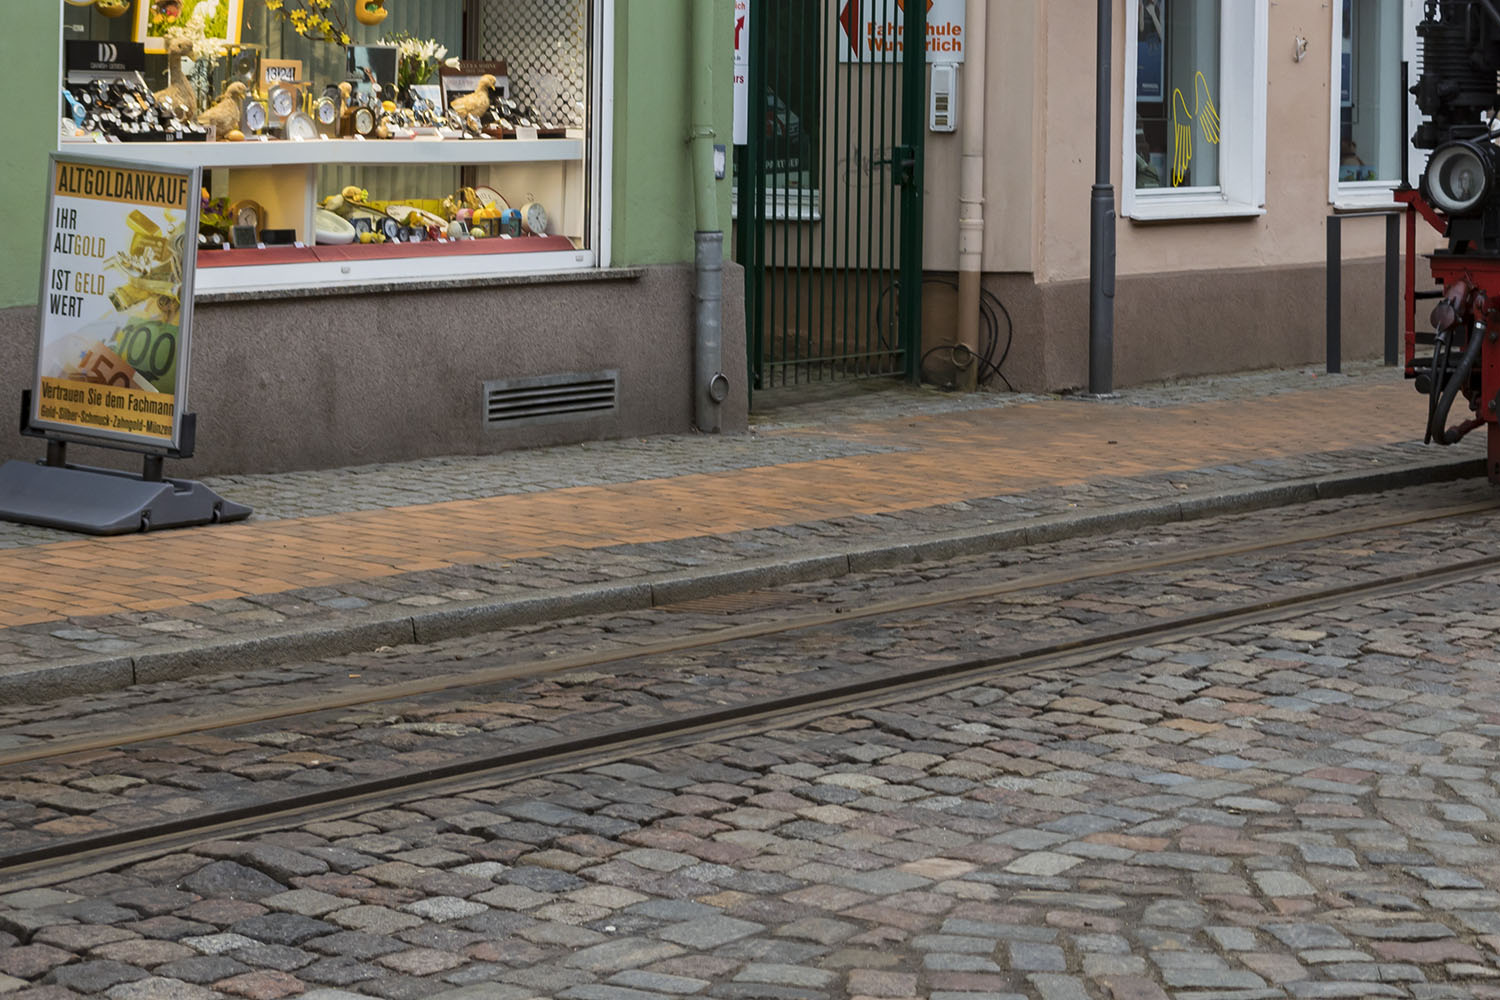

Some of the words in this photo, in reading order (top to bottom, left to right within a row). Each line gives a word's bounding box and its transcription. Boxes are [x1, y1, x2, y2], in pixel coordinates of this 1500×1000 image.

[58, 165, 188, 206] ALTGOLDANKAUF
[56, 207, 78, 230] IHR
[53, 232, 106, 259] ALTGOLD
[51, 268, 71, 291] IST
[75, 271, 105, 296] GELD
[50, 293, 84, 318] WERT
[41, 381, 85, 404] Vertrauen
[88, 387, 102, 406] Sie
[105, 390, 125, 409] dem
[128, 394, 174, 417] Fachmann
